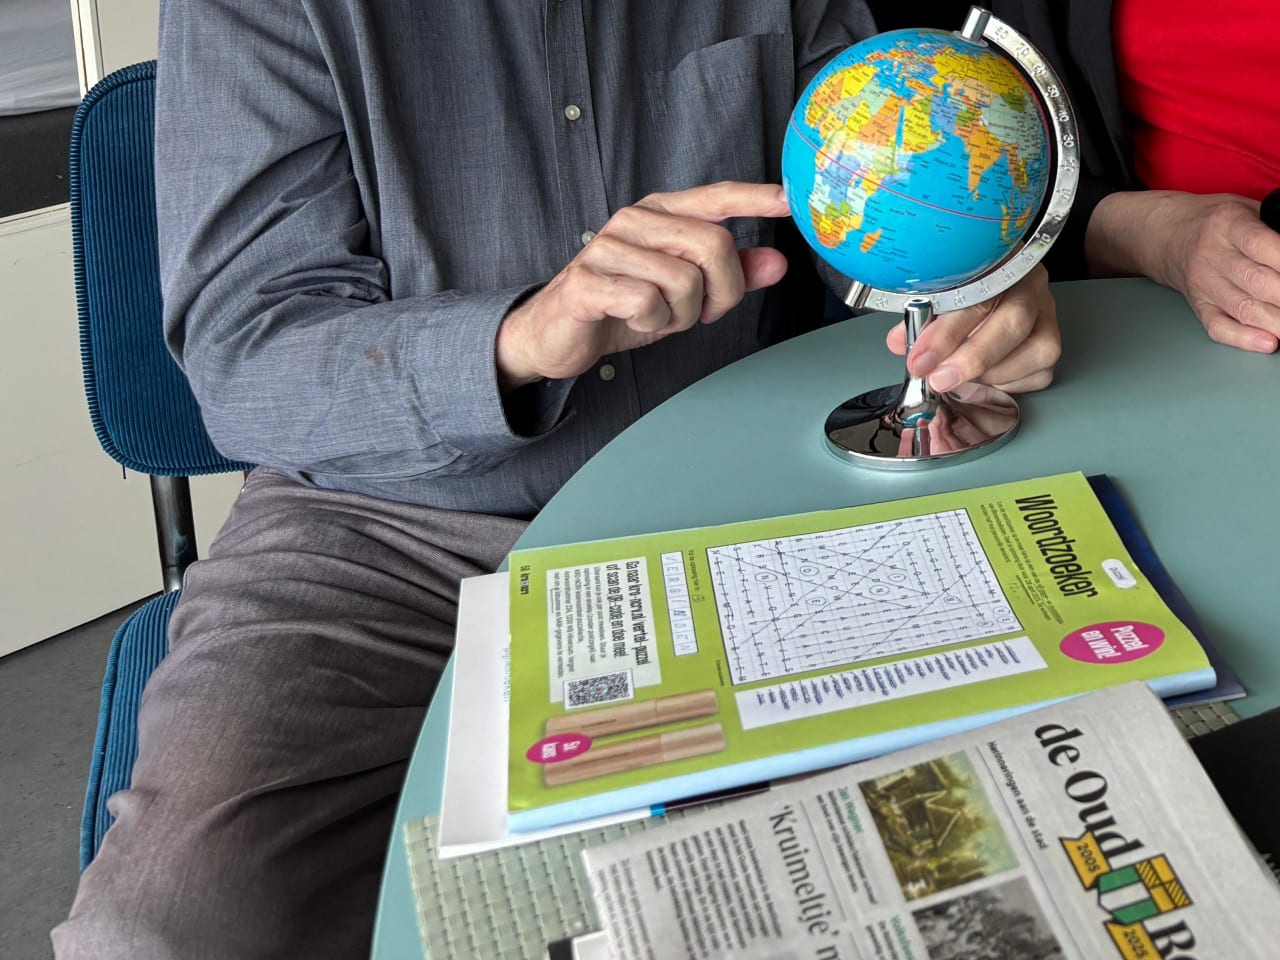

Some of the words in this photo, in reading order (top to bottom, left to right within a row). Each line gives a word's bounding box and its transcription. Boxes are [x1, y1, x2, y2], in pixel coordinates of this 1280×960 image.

[1015, 493, 1099, 599] Woordzoeker
[603, 563, 618, 571] of
[624, 560, 639, 569] Ga
[604, 571, 620, 586] scan
[624, 568, 641, 584] naar
[606, 586, 621, 595] de
[609, 619, 626, 629] en
[610, 628, 627, 641] doe
[1081, 629, 1104, 644] en
[1110, 624, 1149, 651] Puzzel
[612, 640, 629, 658] mee!
[1090, 637, 1121, 659] win!
[984, 740, 1023, 797] Herinneringen
[1035, 723, 1087, 767] de
[1064, 769, 1144, 860] Oud
[1014, 797, 1032, 815] aan
[1023, 814, 1039, 829] de
[1030, 828, 1050, 850] stad
[1075, 842, 1102, 872] 2005
[1120, 928, 1150, 959] 2025
